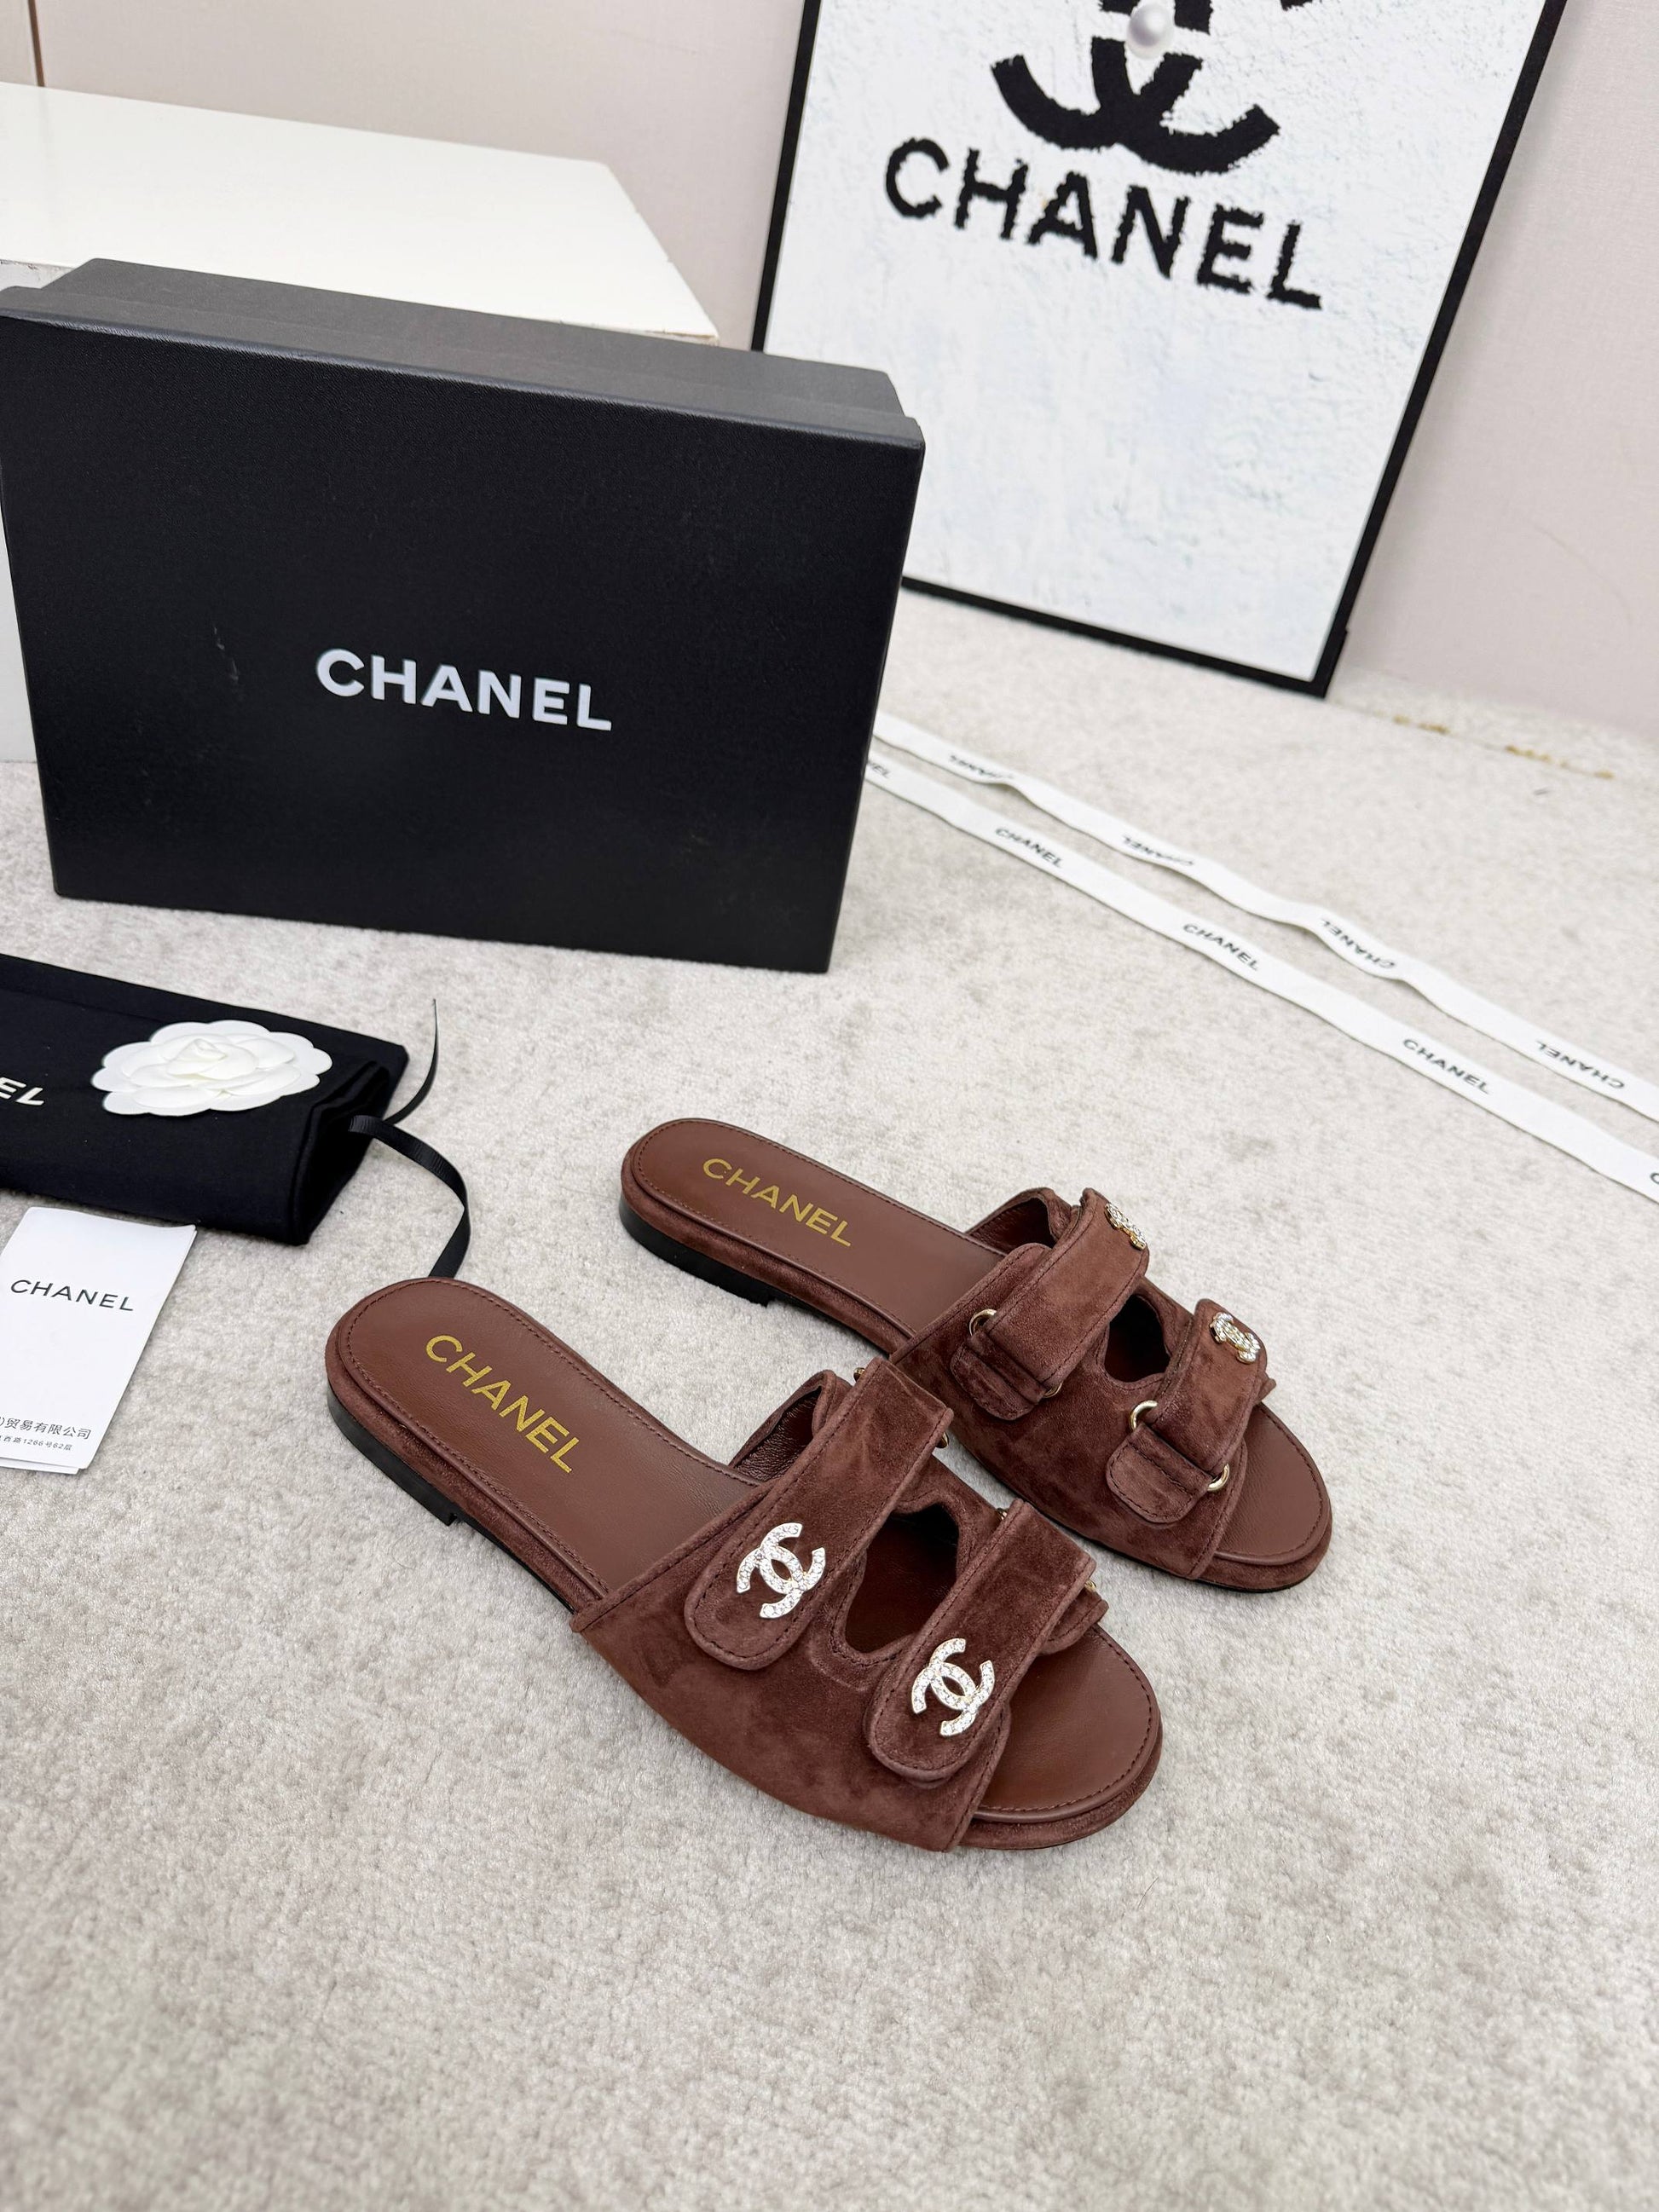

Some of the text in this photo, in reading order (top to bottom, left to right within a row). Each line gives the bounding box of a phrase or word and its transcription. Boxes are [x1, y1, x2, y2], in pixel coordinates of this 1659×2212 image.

[886, 137, 1322, 310] CHANEL
[315, 648, 612, 731] CHANEL
[995, 827, 1064, 869] CHANEL
[1182, 922, 1259, 971] CHANEL
[1320, 918, 1396, 970] CHANEL
[1402, 1037, 1491, 1094] CHANEL
[1535, 1040, 1625, 1089] CHANEL
[702, 1158, 852, 1247] CHANEL
[10, 1279, 134, 1311] CHANEL
[0, 1416, 92, 1440] )贸易有限公司
[425, 1334, 580, 1473] CHANEL
